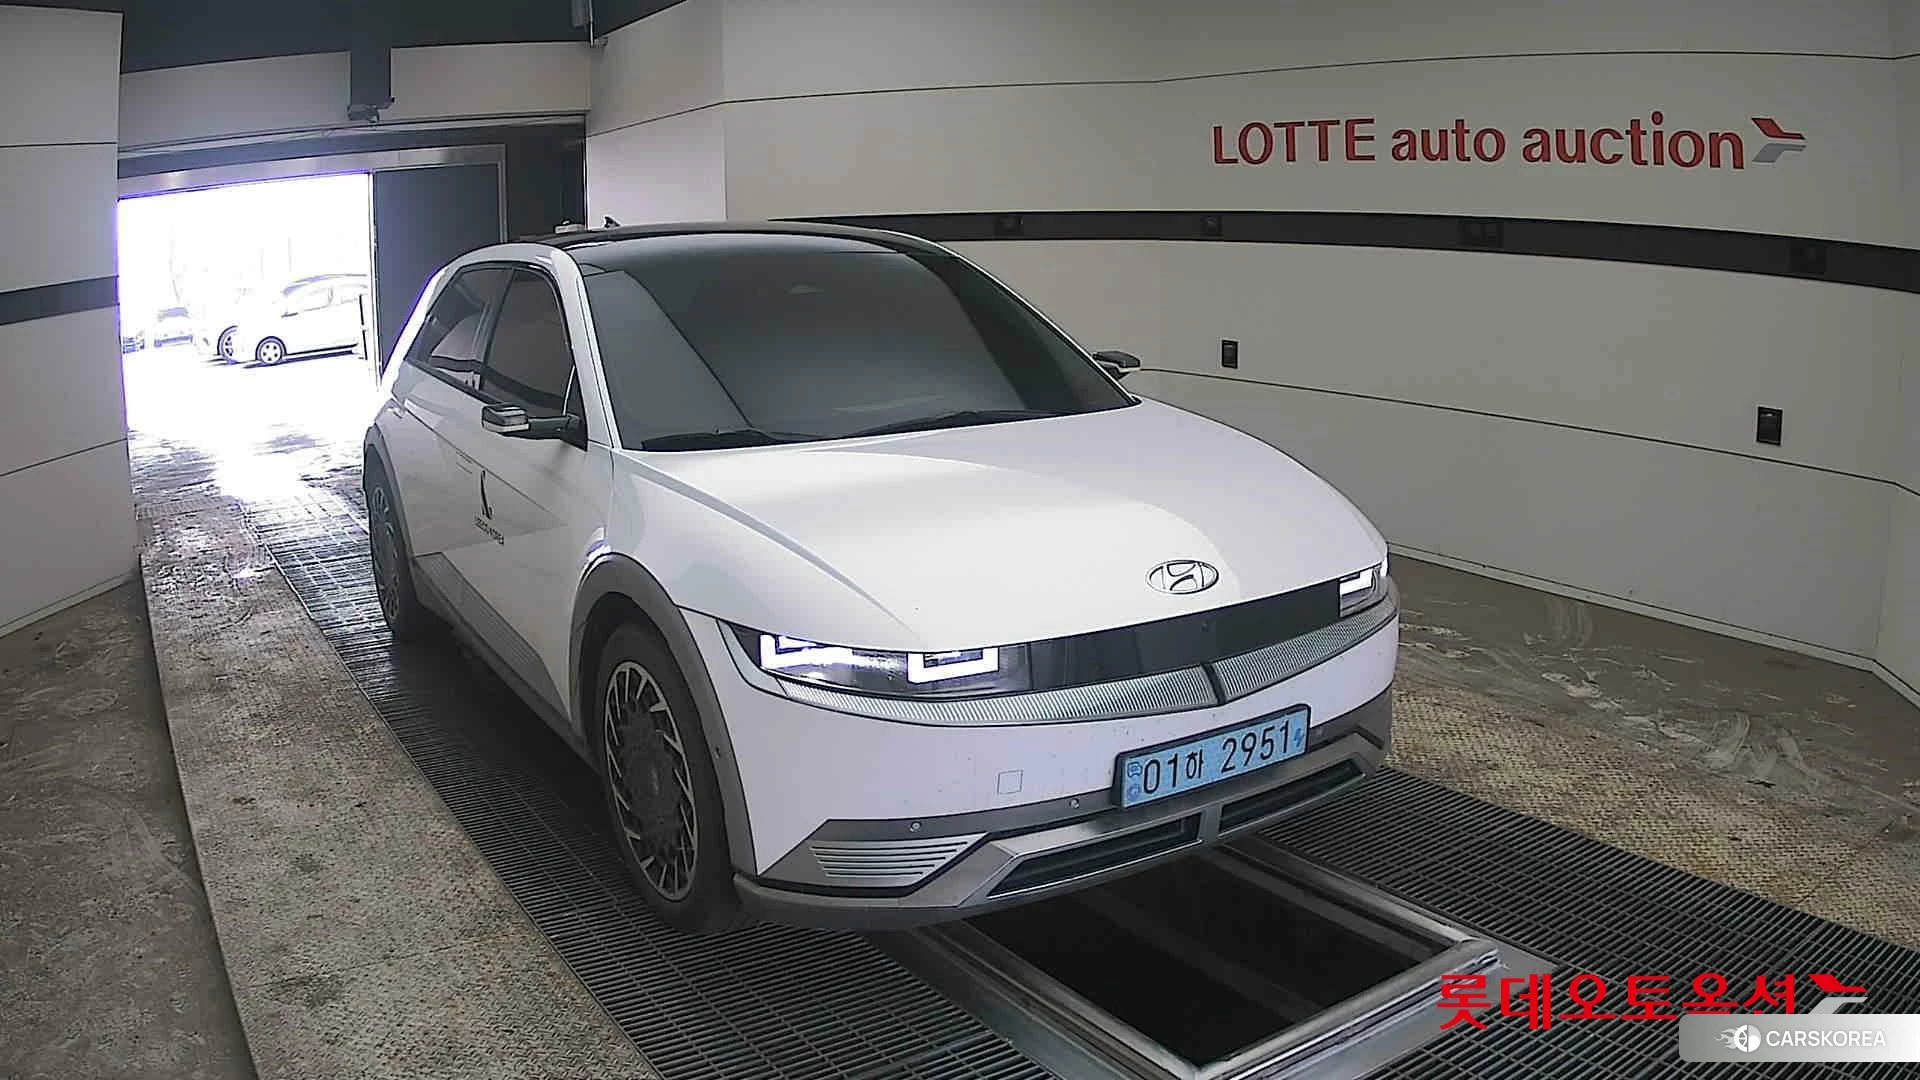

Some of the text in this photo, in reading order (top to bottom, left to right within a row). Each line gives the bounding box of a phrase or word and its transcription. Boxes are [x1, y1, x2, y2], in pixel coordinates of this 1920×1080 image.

[1214, 112, 1745, 169] LOTTE auto auction
[1143, 720, 1290, 795] 01하 2951
